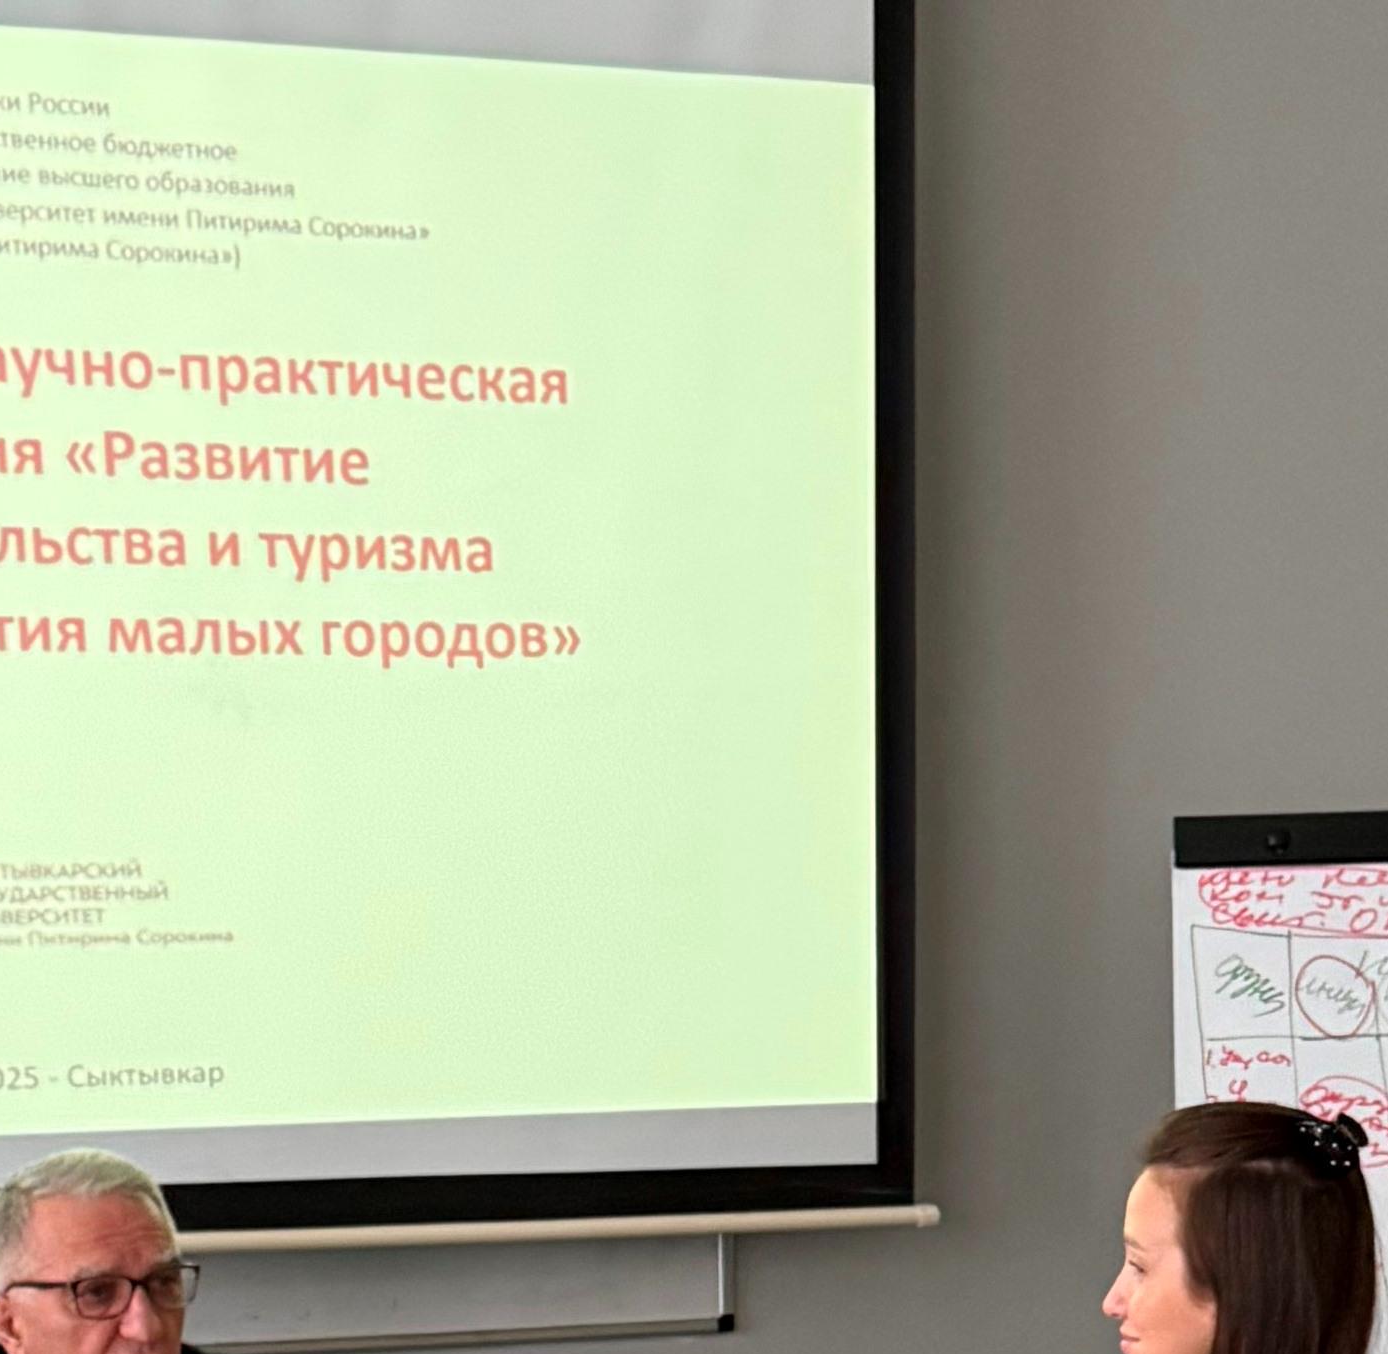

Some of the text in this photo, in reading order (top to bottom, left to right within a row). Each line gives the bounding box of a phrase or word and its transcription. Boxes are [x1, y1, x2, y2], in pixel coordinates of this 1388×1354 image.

[28, 92, 110, 117] России
[103, 132, 238, 161] бюджетное
[38, 169, 140, 191] высшего
[145, 170, 295, 198] образования
[103, 210, 179, 227] имени
[186, 208, 302, 237] Питирима
[308, 216, 430, 241] Сорокина»
[106, 239, 241, 271] Сорокина»)
[66, 431, 369, 486] «Развитие
[209, 532, 240, 567] и
[258, 533, 493, 583] туризма
[109, 617, 304, 656] малых
[322, 620, 580, 670] городов»
[27, 931, 131, 948] Питирима
[135, 928, 234, 947] Сорокина
[67, 1064, 224, 1088] Сыктывкар
